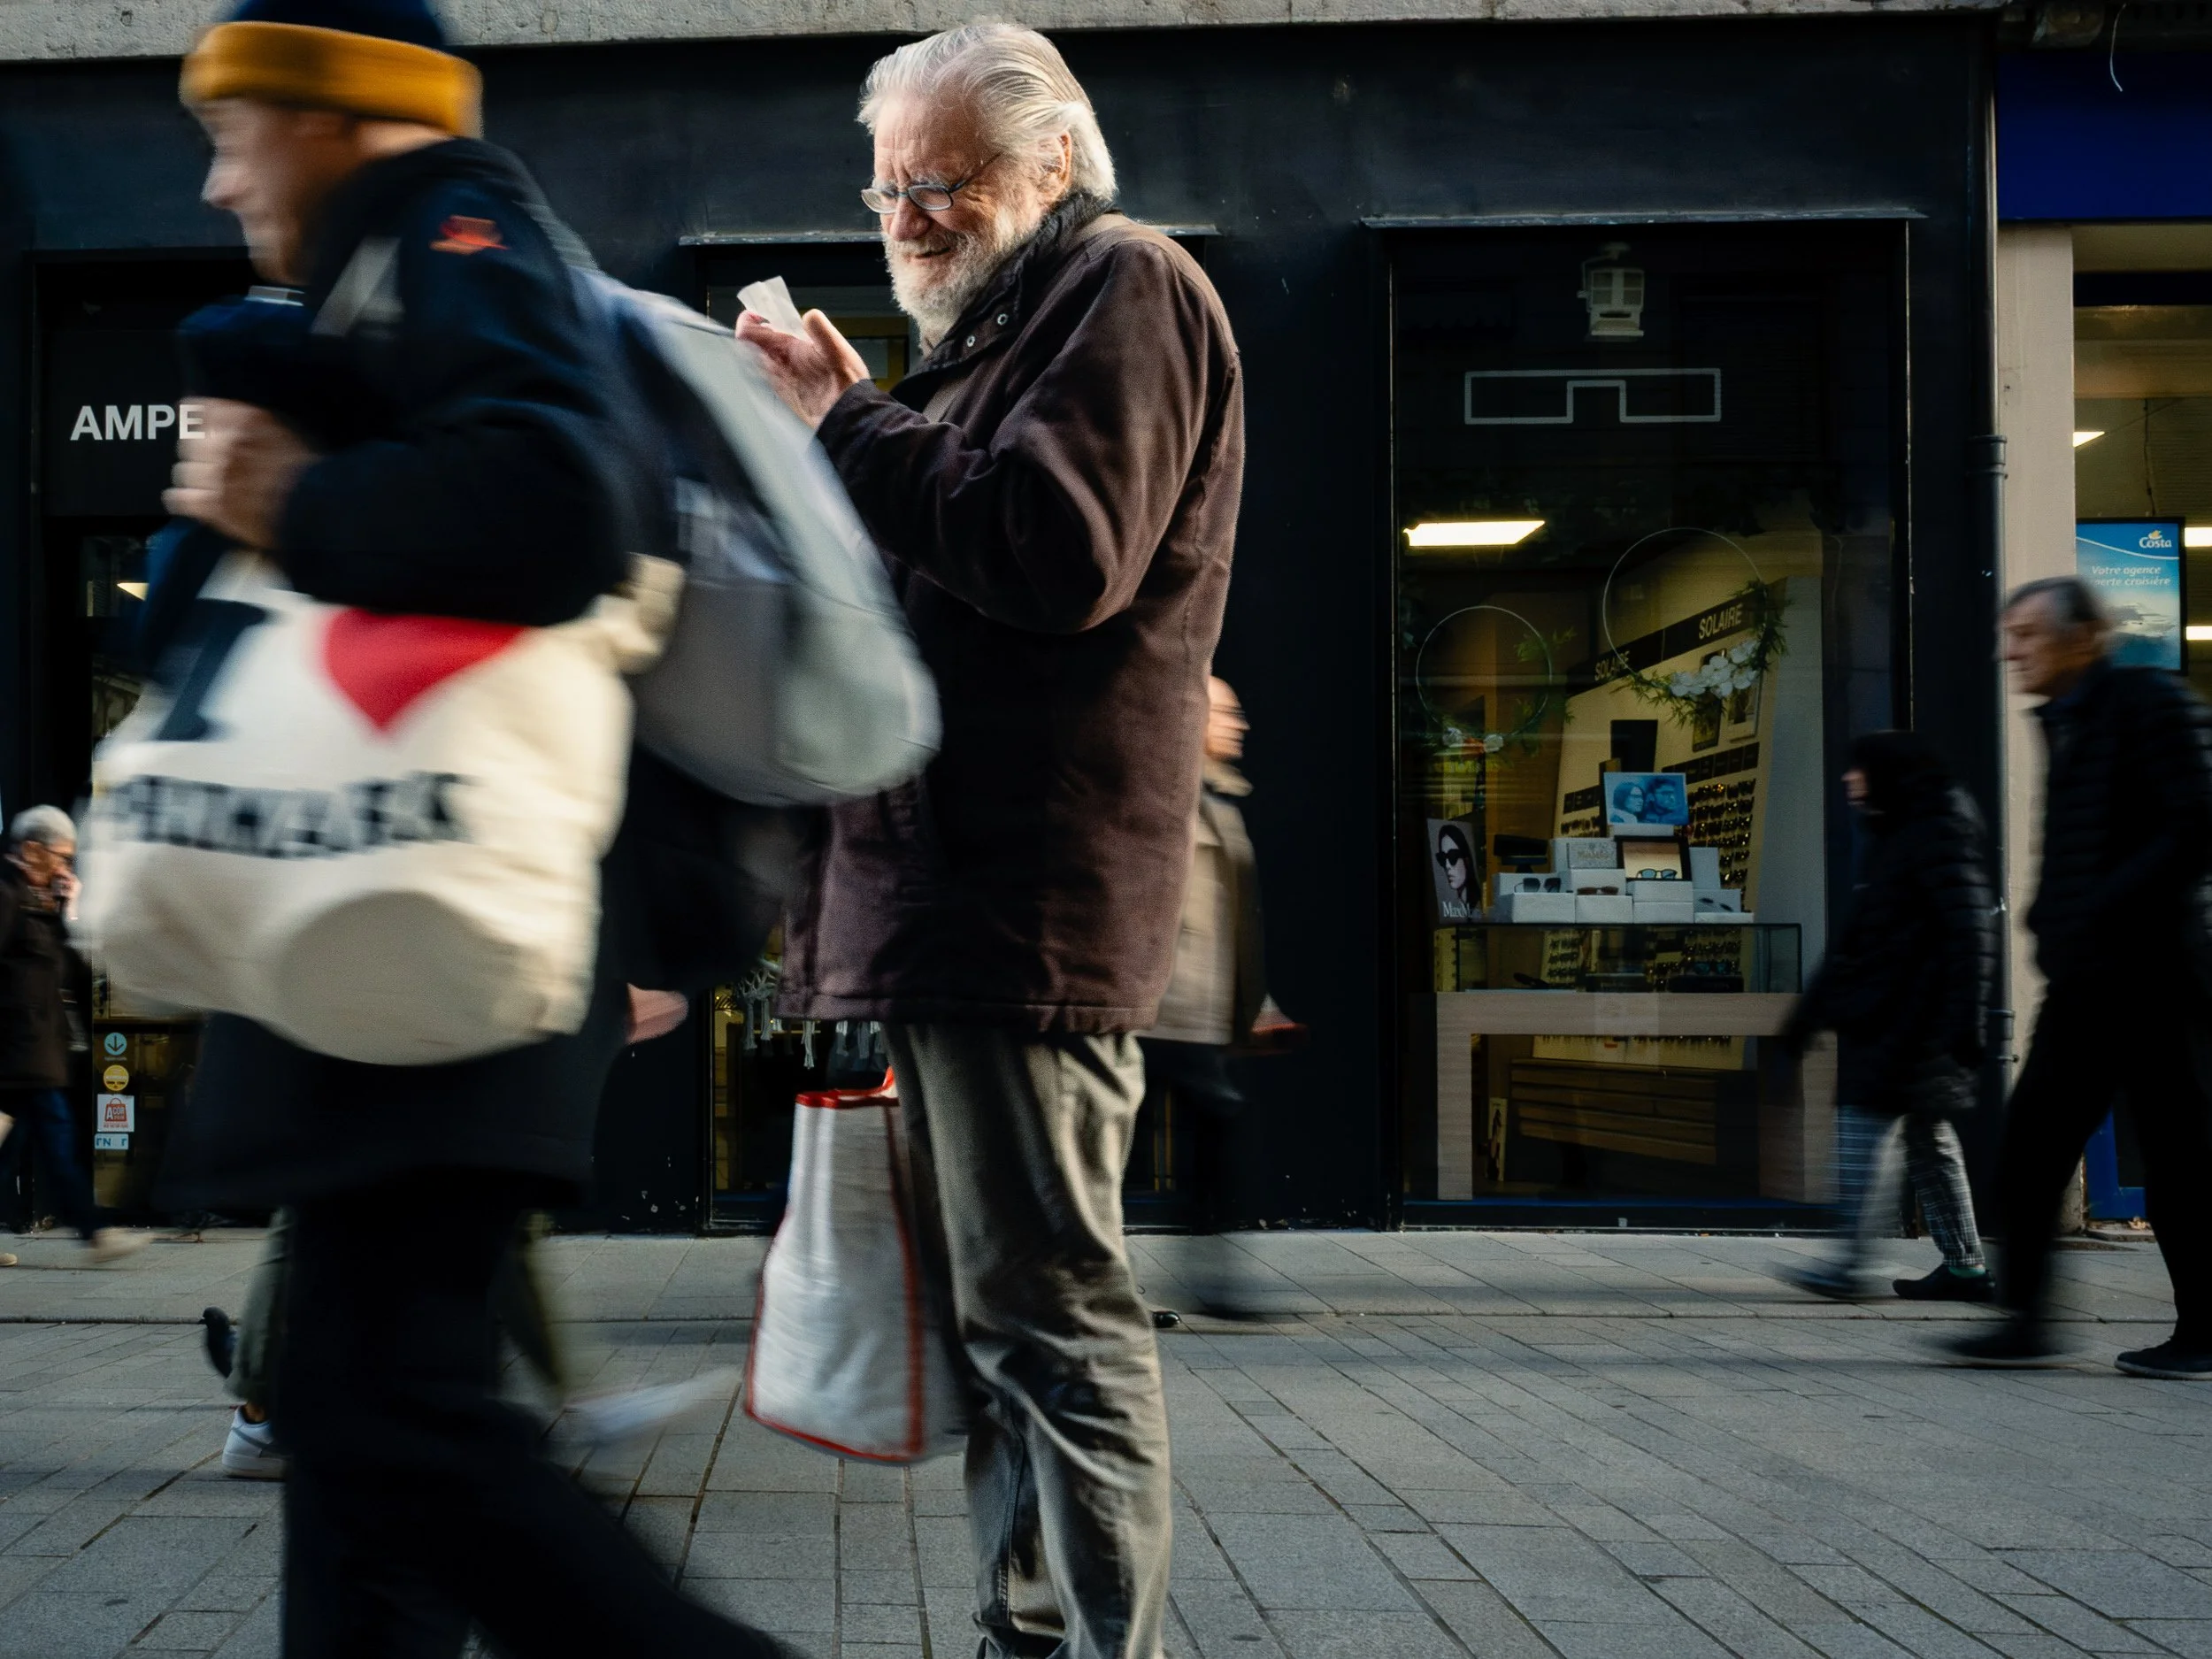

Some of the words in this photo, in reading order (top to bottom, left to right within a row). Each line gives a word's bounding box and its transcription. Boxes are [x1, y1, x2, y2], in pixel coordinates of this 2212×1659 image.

[70, 403, 206, 442] AMPE
[2139, 536, 2172, 549] Costa
[2092, 566, 2122, 575] Votre
[2123, 566, 2162, 577] agence
[1698, 602, 1743, 640] SOLAIRE
